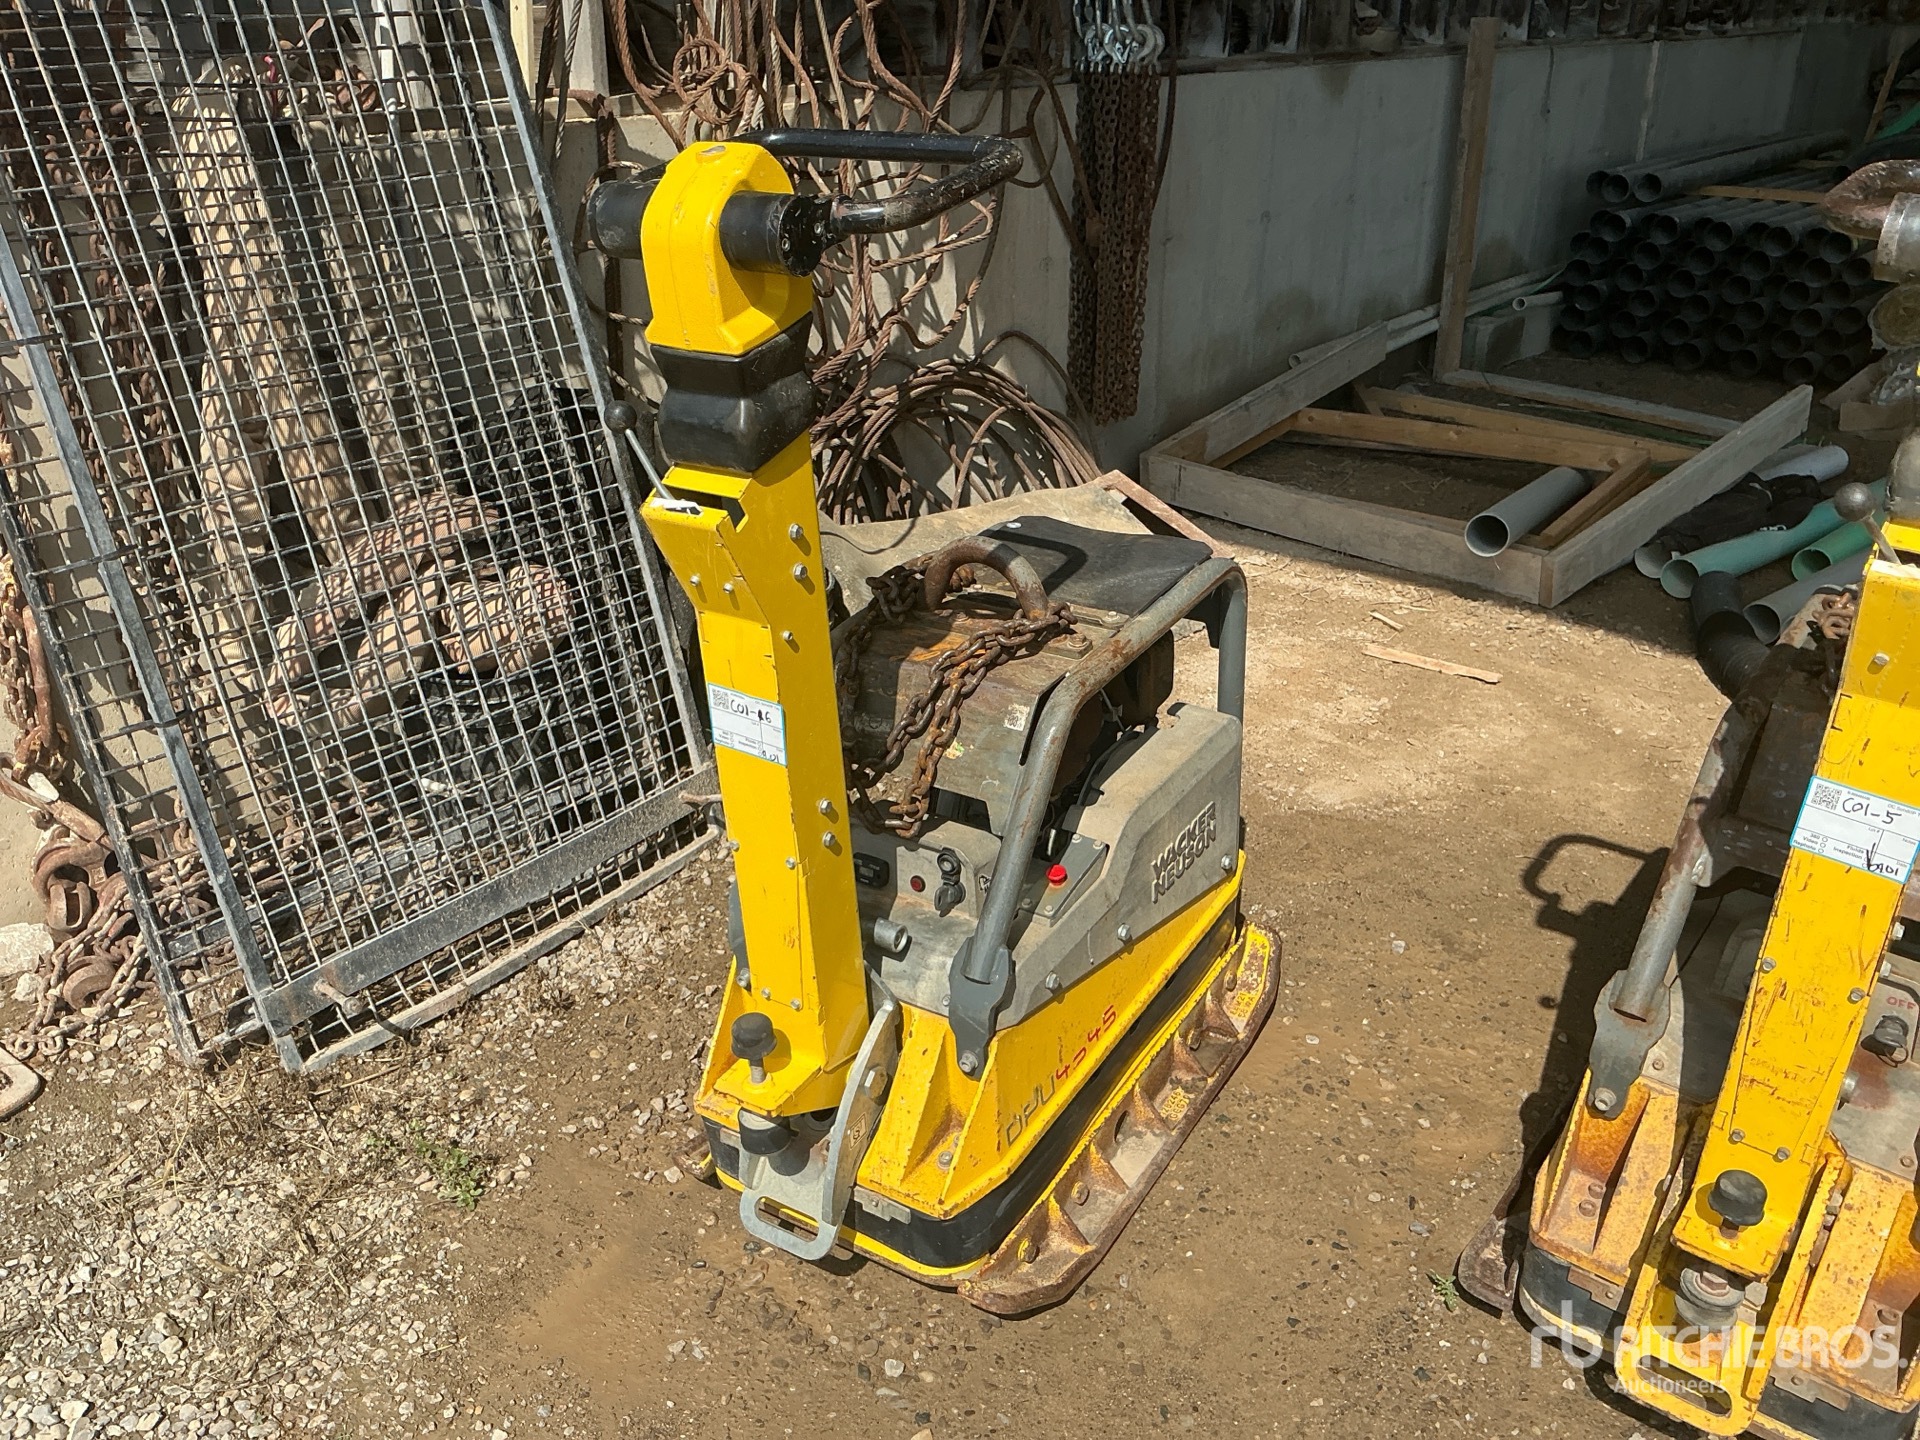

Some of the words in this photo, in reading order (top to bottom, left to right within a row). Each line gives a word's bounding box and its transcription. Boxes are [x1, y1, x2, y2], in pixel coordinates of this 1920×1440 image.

[1150, 801, 1216, 880] WACKER
[1151, 820, 1216, 904] NEUSON
[1886, 996, 1916, 1010] OFF
